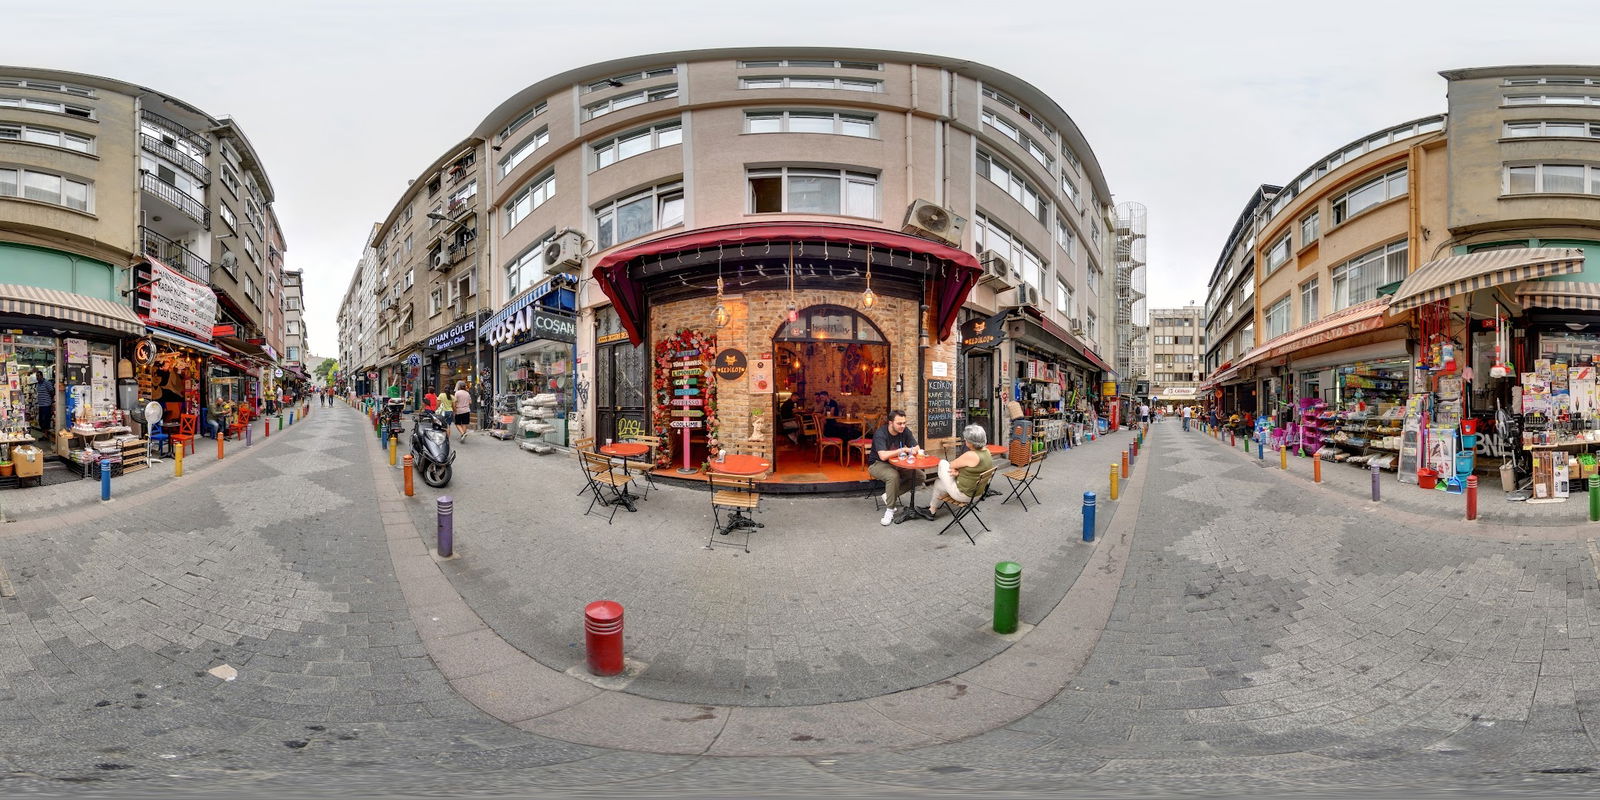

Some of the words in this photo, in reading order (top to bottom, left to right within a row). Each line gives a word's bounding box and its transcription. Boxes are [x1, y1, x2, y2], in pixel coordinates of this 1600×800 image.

[428, 332, 449, 347] AYHAN
[450, 321, 475, 337] GÜLER
[454, 335, 465, 344] Club
